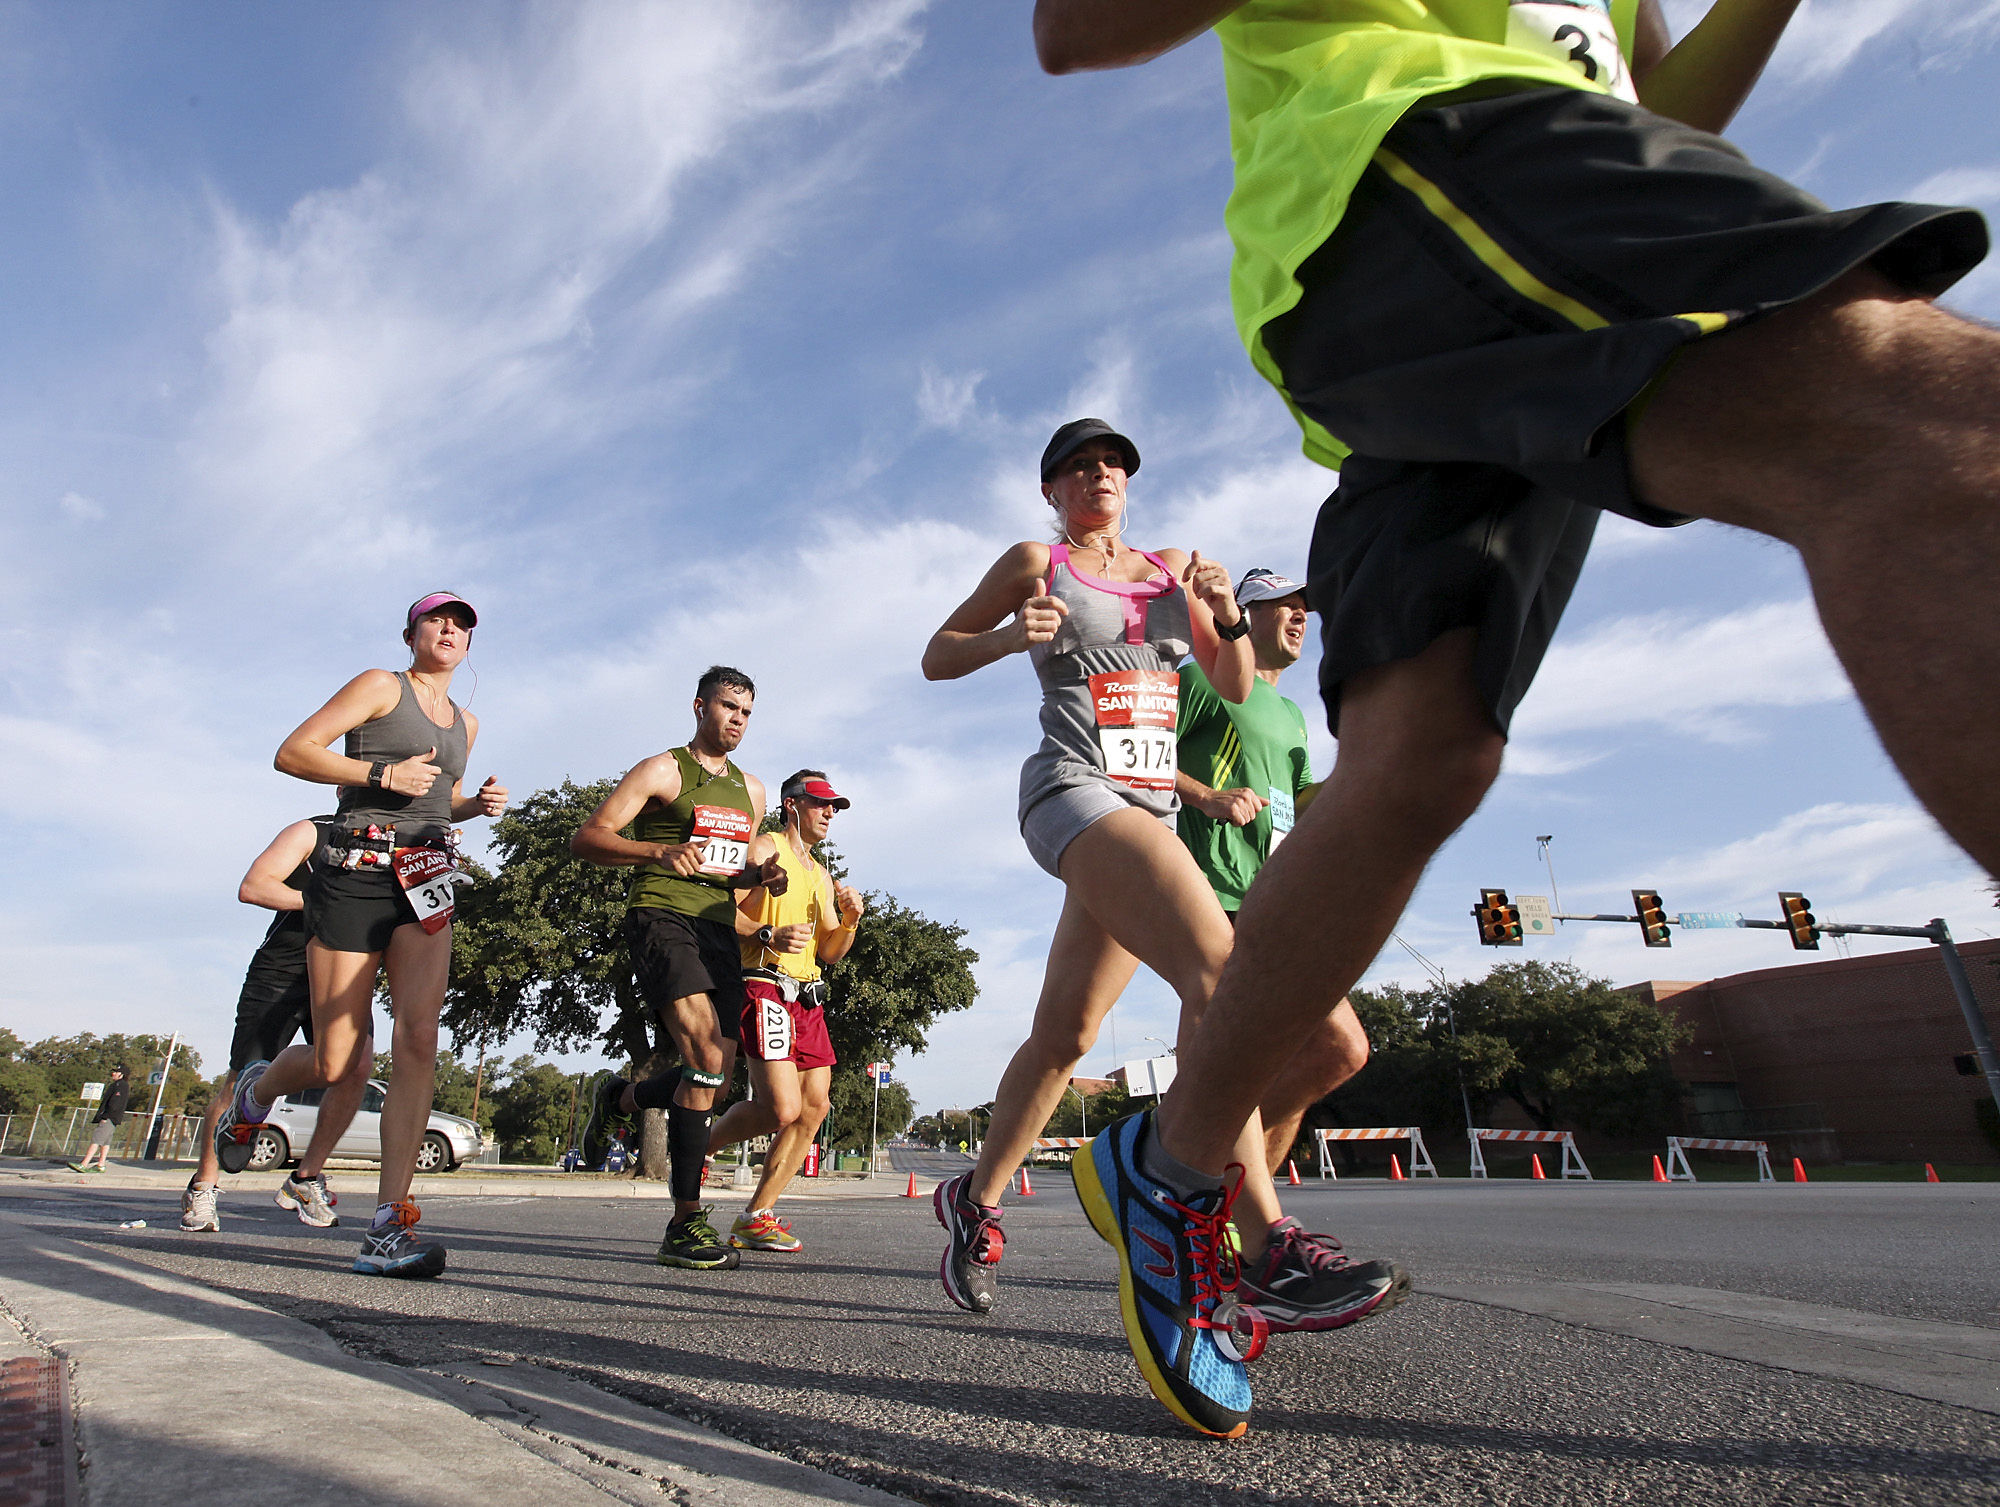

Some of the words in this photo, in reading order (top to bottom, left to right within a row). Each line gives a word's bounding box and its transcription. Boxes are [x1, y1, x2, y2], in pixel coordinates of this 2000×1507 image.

[1104, 682, 1147, 694] Rock
[1157, 682, 1178, 695] Roll
[1098, 695, 1134, 712] SAN
[1137, 695, 1178, 713] ANTONI
[1120, 738, 1172, 771] 3174
[697, 817, 716, 829] SAN
[715, 820, 751, 833] ANTONIO
[1284, 811, 1294, 823] ANT
[401, 850, 429, 863] Rock
[399, 860, 426, 878] SAN
[427, 855, 448, 867] ANT
[424, 863, 447, 875] marat
[767, 1005, 785, 1050] 2210
